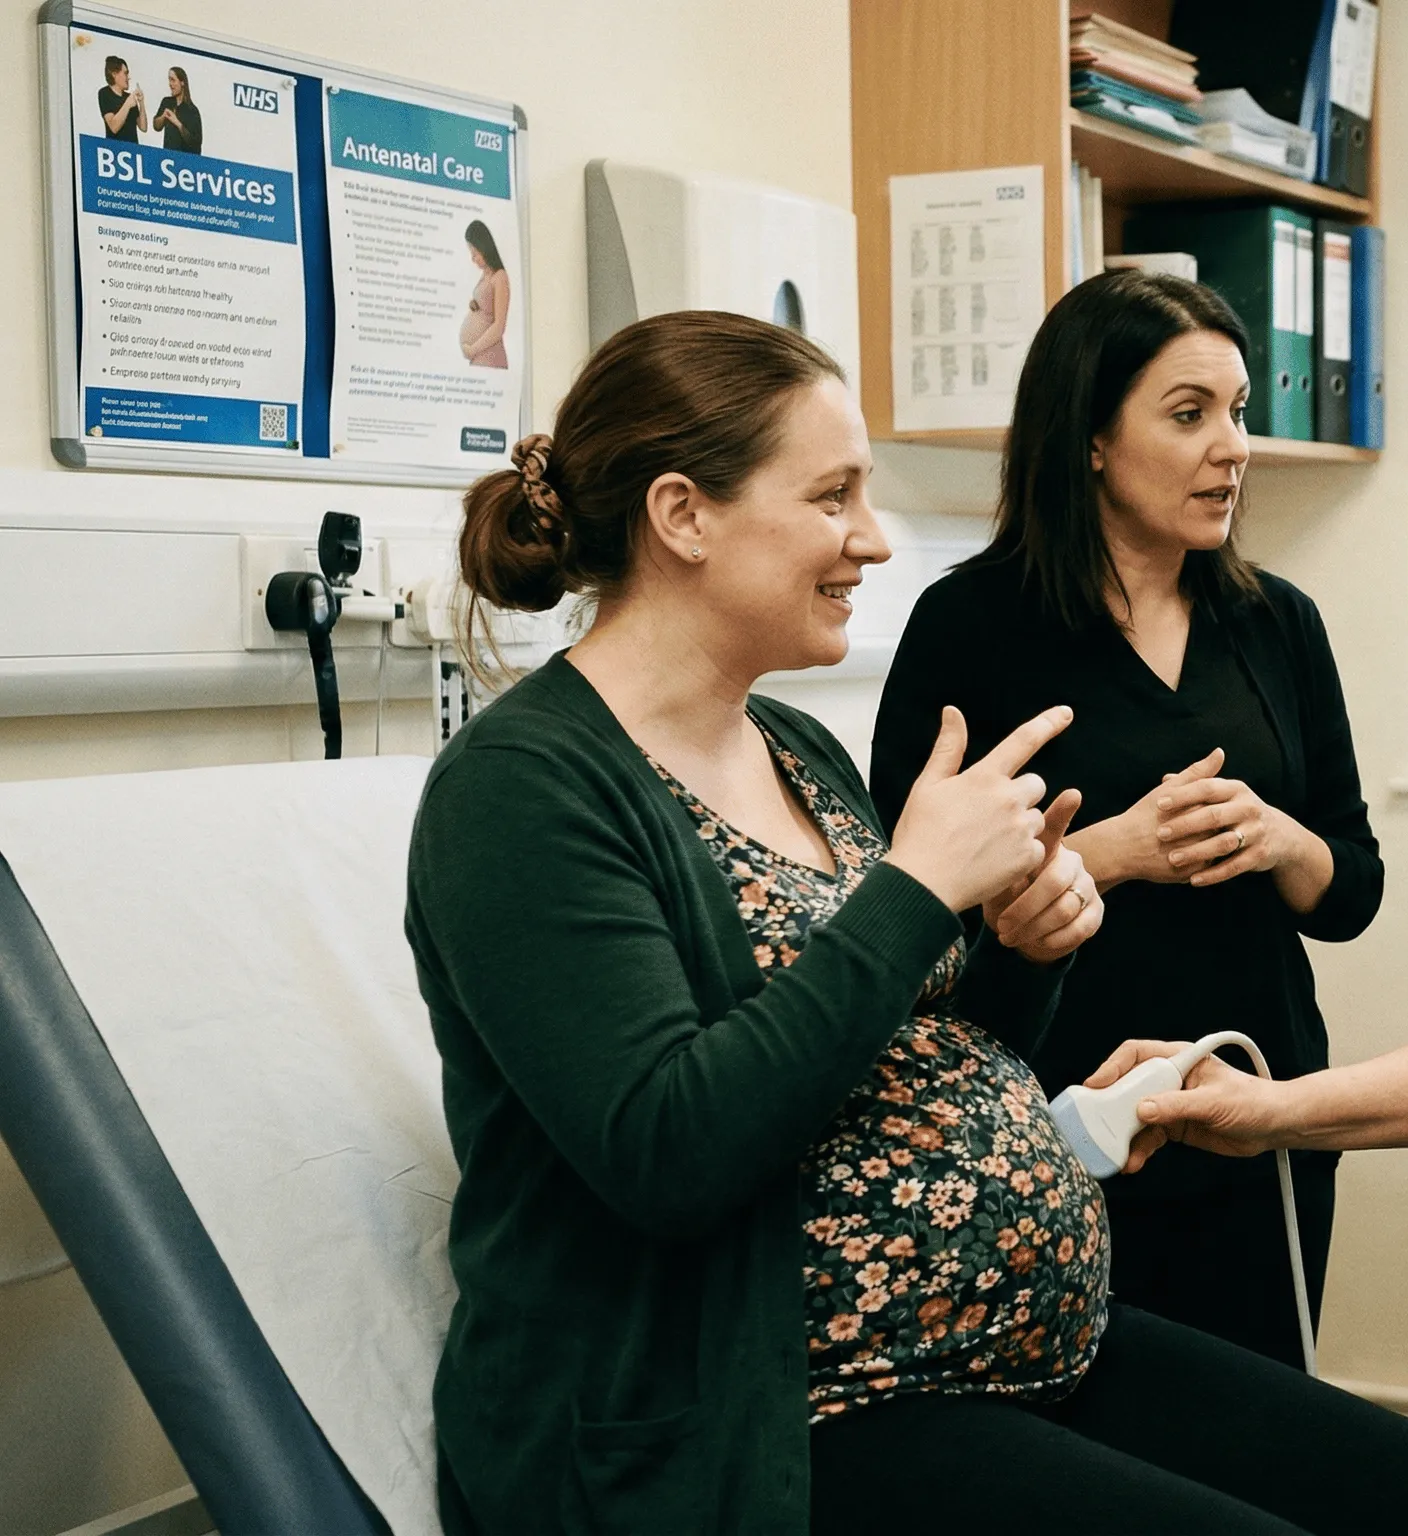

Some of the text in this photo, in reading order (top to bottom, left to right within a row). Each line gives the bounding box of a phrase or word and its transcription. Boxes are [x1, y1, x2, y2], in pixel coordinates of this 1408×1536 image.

[234, 84, 278, 113] NHS
[97, 147, 276, 206] BSL Services
[343, 137, 484, 184] Antenatal Care
